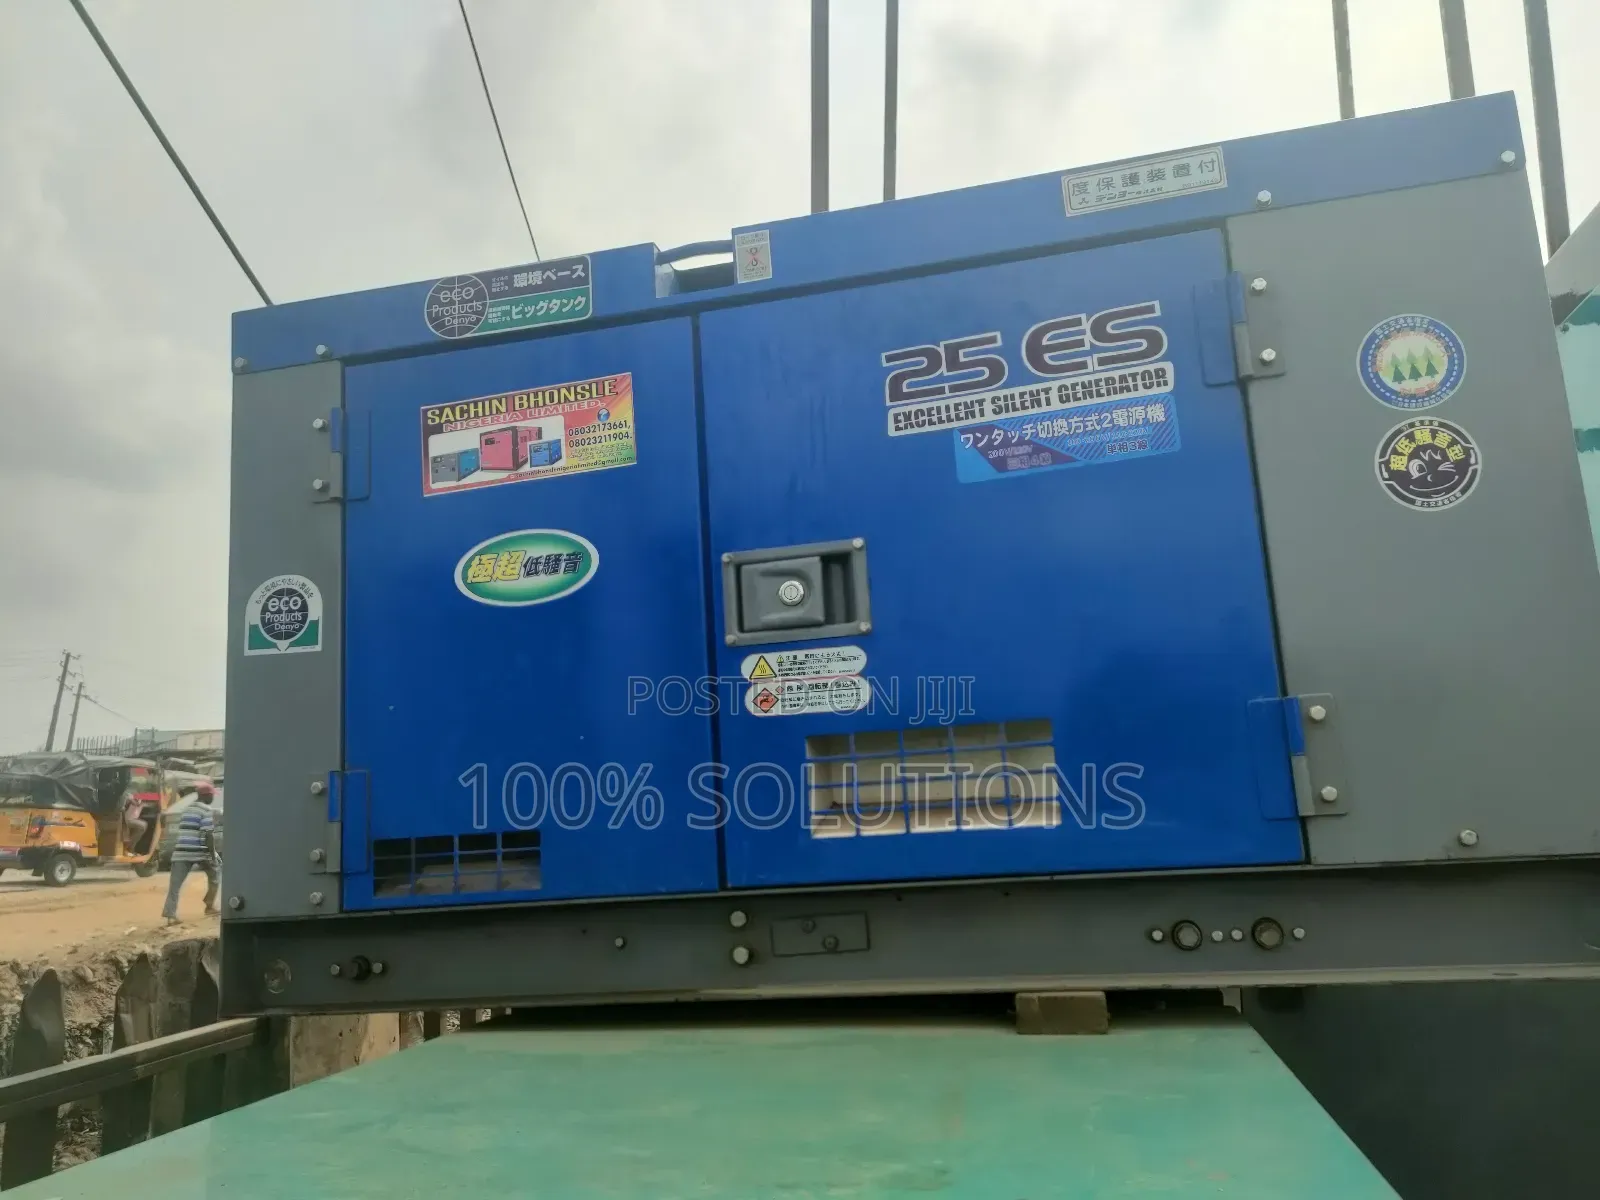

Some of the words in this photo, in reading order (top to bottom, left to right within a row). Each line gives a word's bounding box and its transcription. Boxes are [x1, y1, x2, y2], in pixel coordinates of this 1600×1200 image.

[513, 264, 585, 288] 環境ベース
[440, 286, 474, 303] eco
[432, 300, 483, 318] Products
[511, 295, 586, 320] ビッグタンク
[445, 314, 476, 327] Denyo
[881, 331, 1008, 406] 25
[1021, 300, 1168, 378] ES
[427, 397, 507, 425] SACHIN
[514, 379, 619, 406] BHONSLE
[892, 398, 987, 432] EXCELLENT
[991, 386, 1053, 416] SILENT
[1056, 367, 1169, 404] GENERATOR
[443, 410, 523, 432] NIGERIA
[527, 399, 606, 421] LIMITED.
[960, 402, 1167, 449] ワンタッチ切換方式2電源機
[568, 420, 631, 437] 08032173661,
[568, 431, 633, 448] 08023211904.
[1389, 428, 1466, 471] 超低騒音型
[268, 596, 302, 612] eco
[265, 611, 302, 623] Products
[275, 622, 300, 631] Denyo
